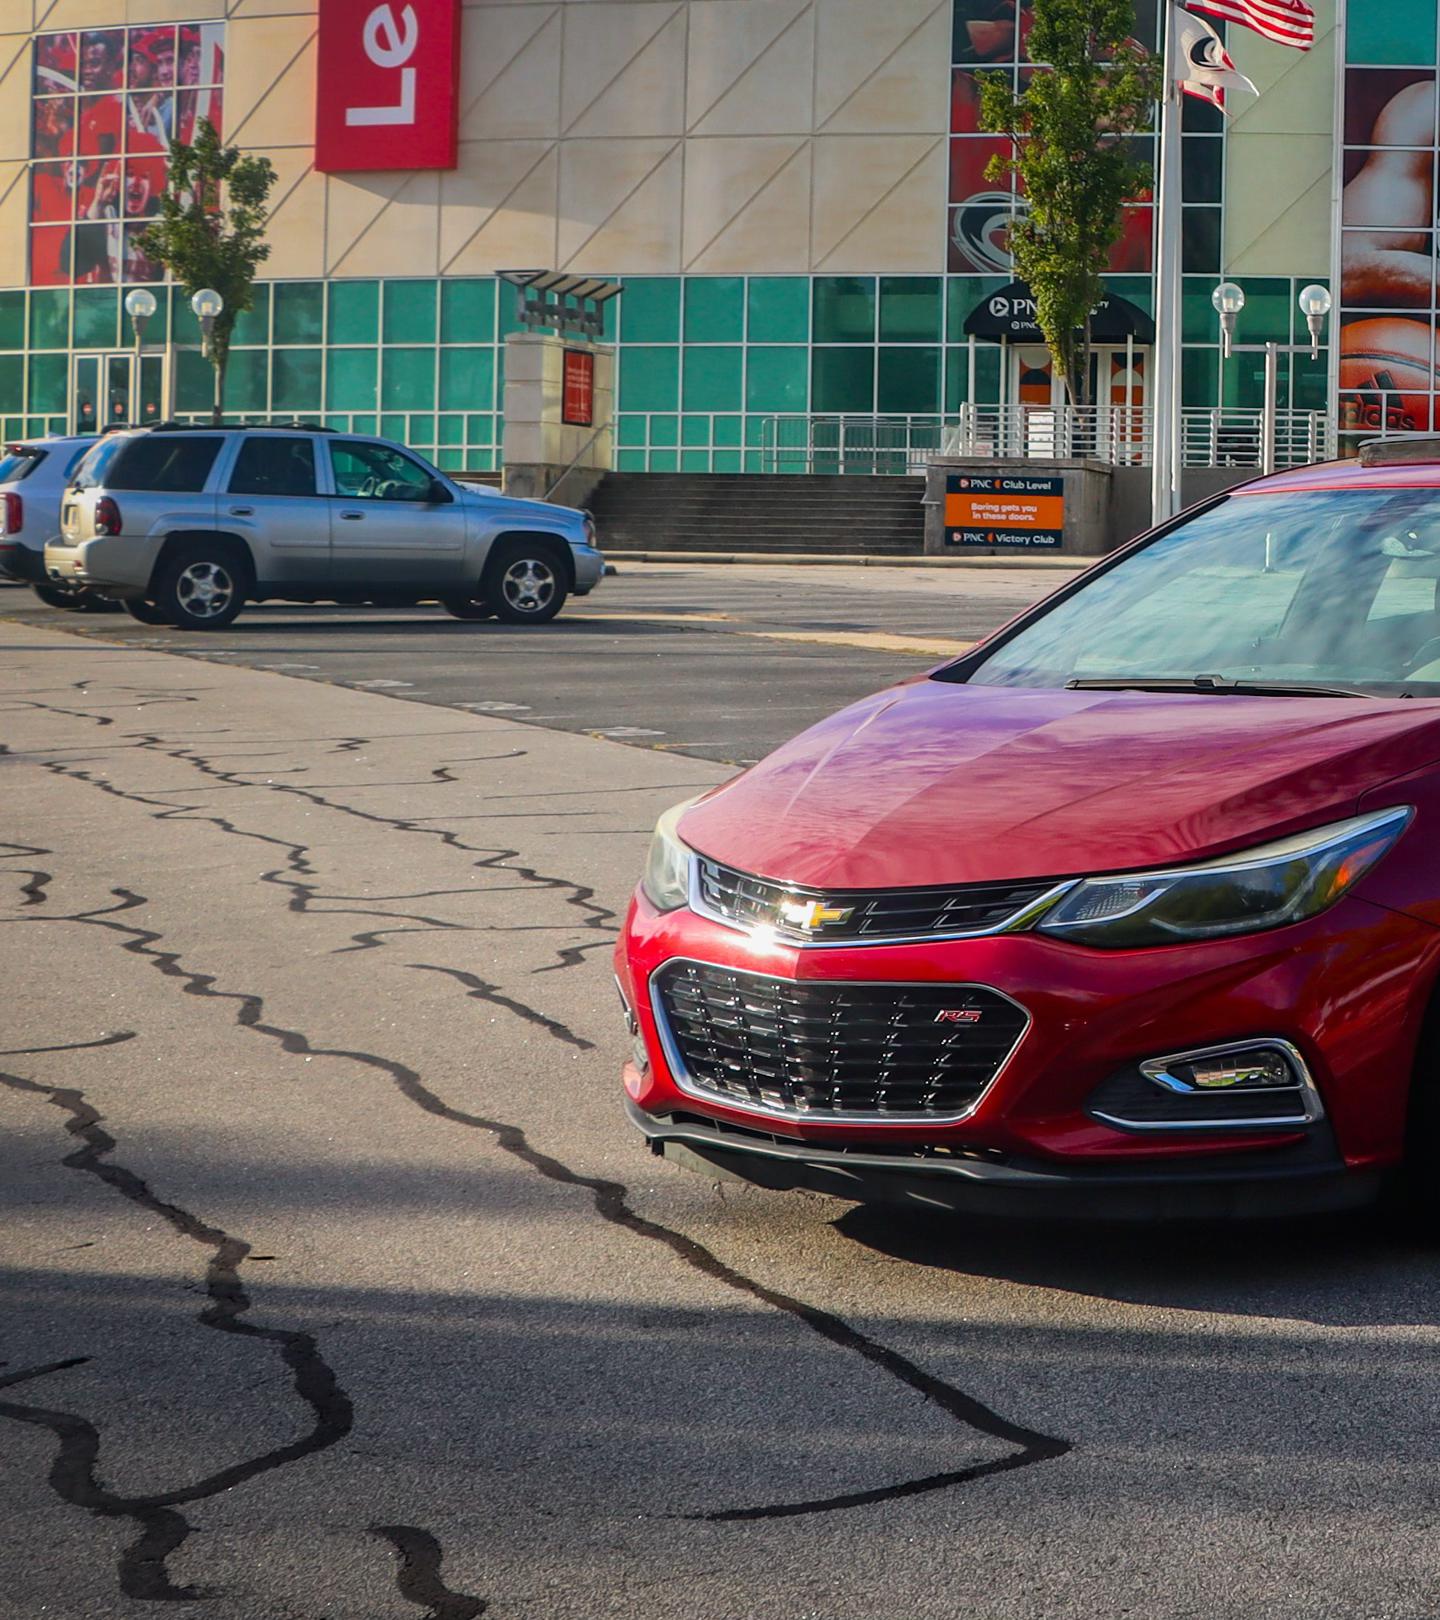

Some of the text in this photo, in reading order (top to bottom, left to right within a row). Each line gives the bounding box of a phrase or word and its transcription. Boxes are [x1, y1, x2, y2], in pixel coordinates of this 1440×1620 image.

[345, 3, 418, 126] Le
[1340, 402, 1416, 430] didas
[970, 480, 1051, 490] PNC Club Level
[971, 502, 1038, 513] Boring gets you
[972, 511, 1036, 521] in these doors.
[963, 533, 1055, 545] PNC Victory Club
[935, 1010, 982, 1022] RS
